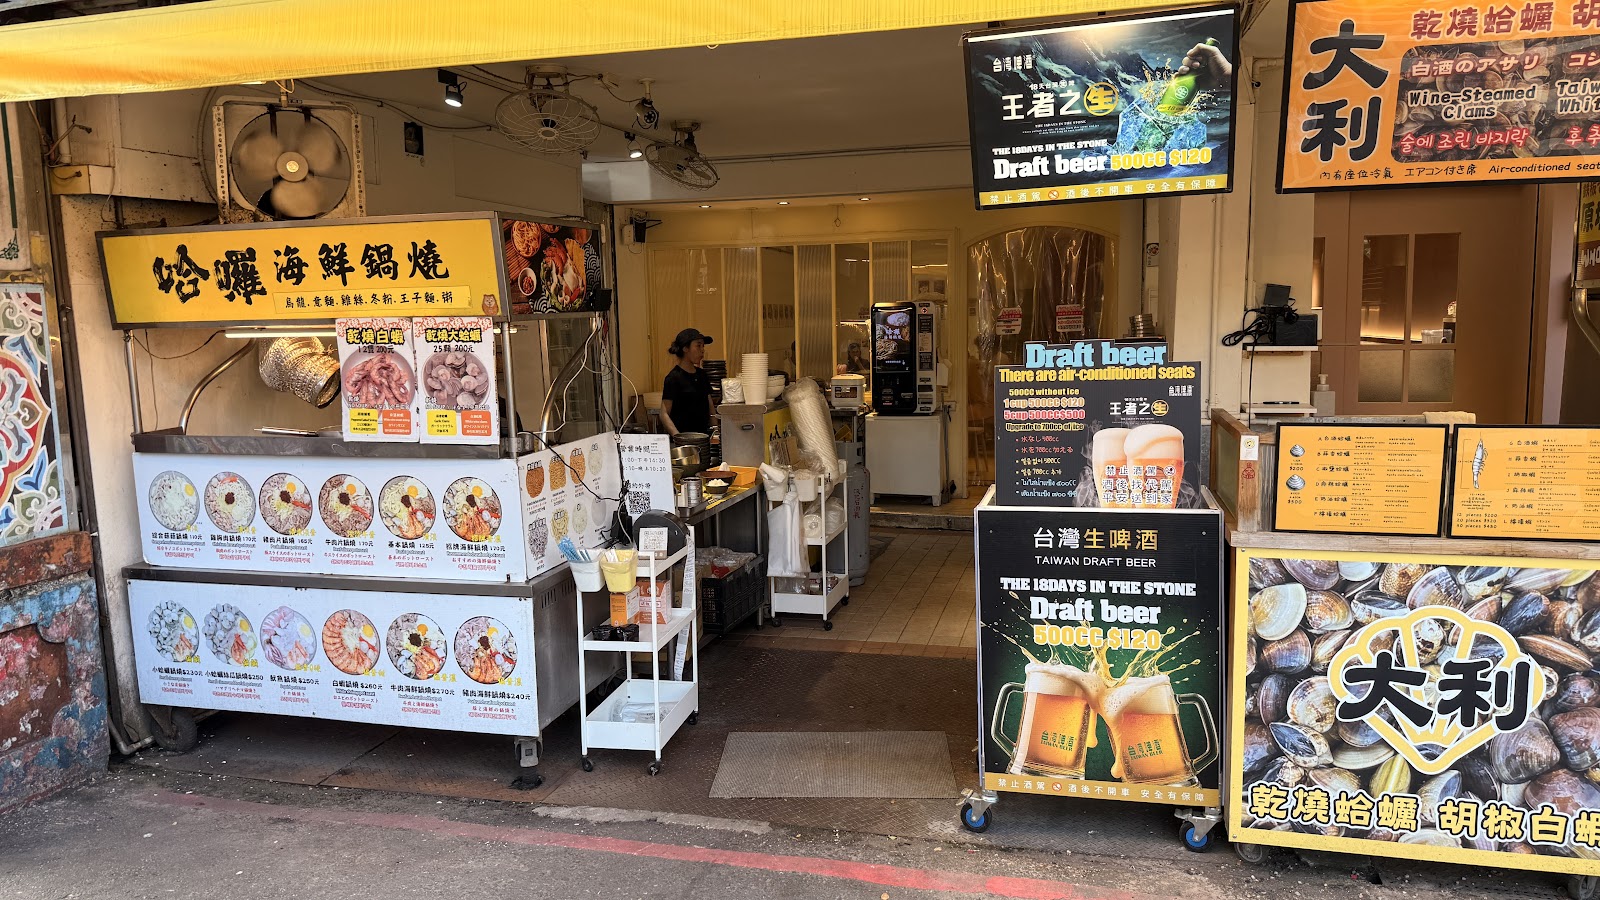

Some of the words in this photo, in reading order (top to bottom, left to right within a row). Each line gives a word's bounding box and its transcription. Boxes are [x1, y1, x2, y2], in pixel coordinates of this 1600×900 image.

[1412, 54, 1541, 78] 白酒のアサリ
[1301, 19, 1389, 162] 大利
[1409, 86, 1537, 108] Wine-Steamed
[1444, 105, 1497, 120] Clams
[992, 147, 1010, 156] THE
[1012, 144, 1044, 155] 18DAYS
[1045, 143, 1056, 152] IN
[1057, 141, 1075, 151] THE
[1077, 138, 1109, 149] STONE
[1400, 132, 1434, 154] 술에
[1438, 130, 1472, 150] 조린
[1476, 128, 1531, 149] 바지락
[993, 157, 1050, 180] Draft
[1055, 154, 1107, 174] beer
[1111, 151, 1166, 171] 500CC
[1169, 147, 1213, 168] $120
[1405, 164, 1479, 178] エアコン付き席
[1489, 162, 1572, 174] Air-conditioned
[989, 192, 1042, 204] 禁止酒駕
[1066, 184, 1134, 199] 酒後不開車
[1147, 178, 1217, 193] 安全有保障
[346, 328, 405, 345] 乾燒白蝦
[1026, 342, 1095, 369] Draft
[1101, 342, 1167, 366] beer
[999, 369, 1035, 383] There
[1036, 370, 1059, 382] are
[1060, 366, 1157, 382] air-conditioned
[1158, 365, 1197, 380] seats
[1029, 398, 1061, 408] 500CC
[1061, 398, 1085, 408] $120
[1106, 465, 1157, 476] 禁止酒駕
[1102, 479, 1173, 491] 酒後找代駕
[1103, 493, 1173, 505] 平安送到家
[1033, 528, 1159, 551] 台灣生啤酒
[1035, 556, 1080, 567] TAIWAN
[1083, 557, 1122, 568] DRAFT
[1126, 557, 1157, 569] BEER
[1000, 577, 1030, 591] THE
[1033, 578, 1087, 593] 18DAYS
[1090, 580, 1106, 594] IN
[1109, 581, 1142, 594] THE
[1144, 582, 1197, 597] STONE
[1030, 597, 1096, 622] Draft
[1100, 599, 1162, 624] beer
[1033, 625, 1104, 648] 500CC
[1108, 627, 1163, 652] $120
[1339, 652, 1532, 731] 大利
[998, 778, 1046, 792] 禁止酒駕
[1068, 783, 1131, 798] 酒後不開車
[1141, 789, 1205, 803] 安全有保障
